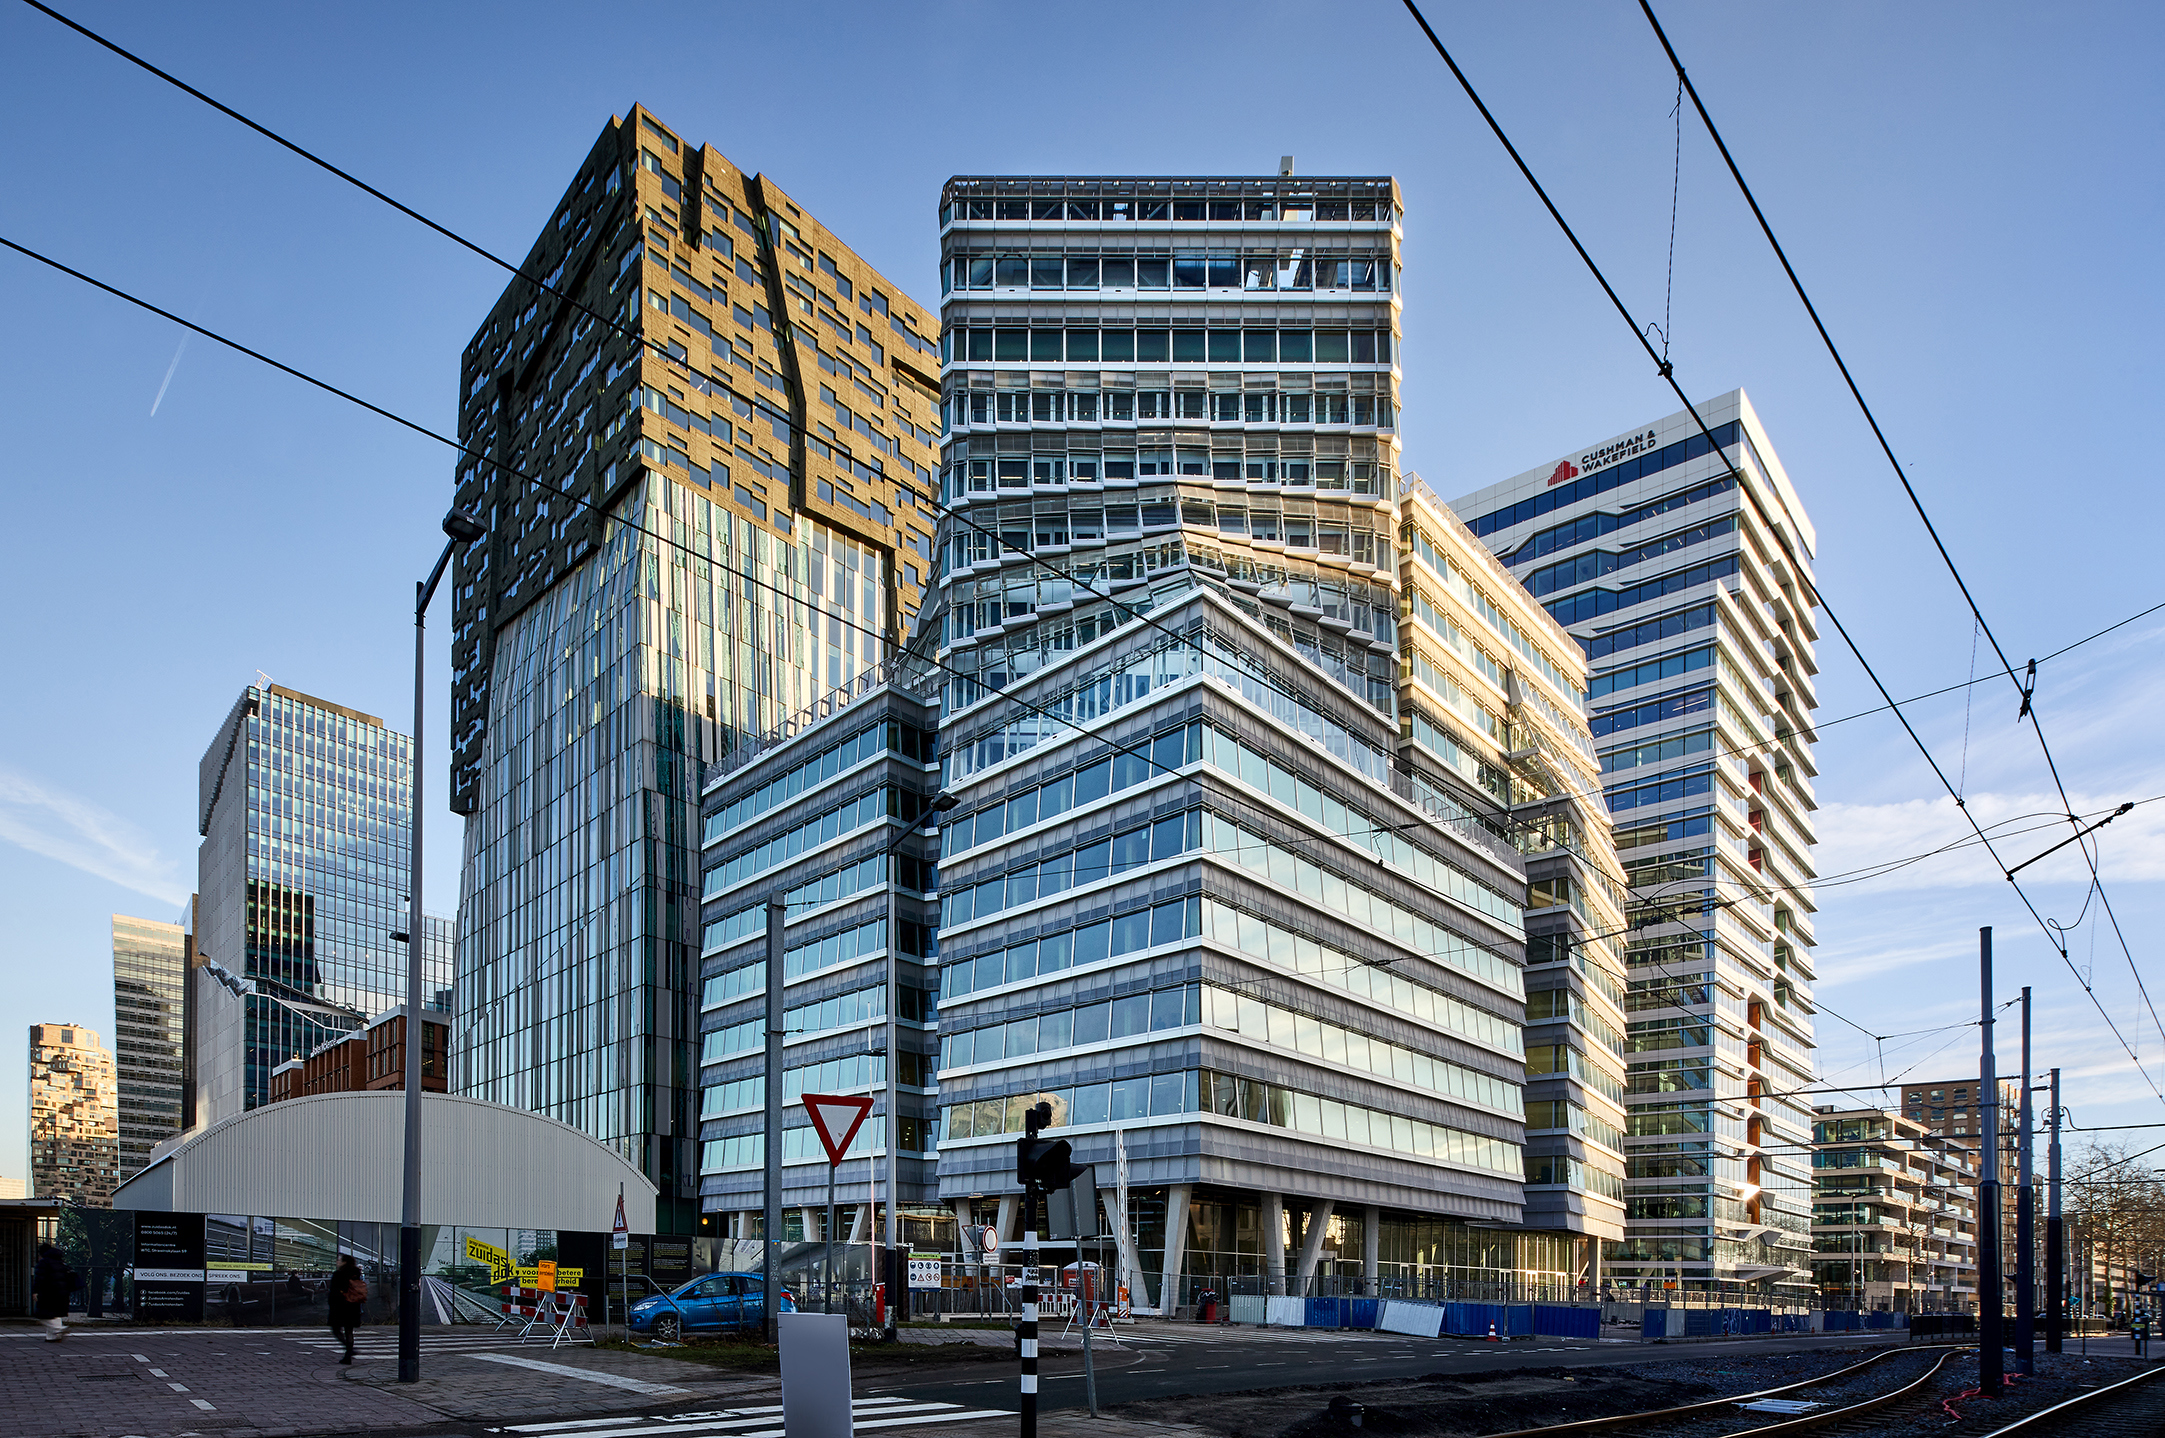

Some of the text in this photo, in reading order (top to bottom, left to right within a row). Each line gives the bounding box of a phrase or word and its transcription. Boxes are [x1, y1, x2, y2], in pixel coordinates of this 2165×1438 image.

[1582, 430, 1656, 464] CUSHMAN &
[1582, 438, 1656, 473] WAKEFIELD
[468, 1240, 490, 1250] programma
[469, 1245, 508, 1268] zuidas
